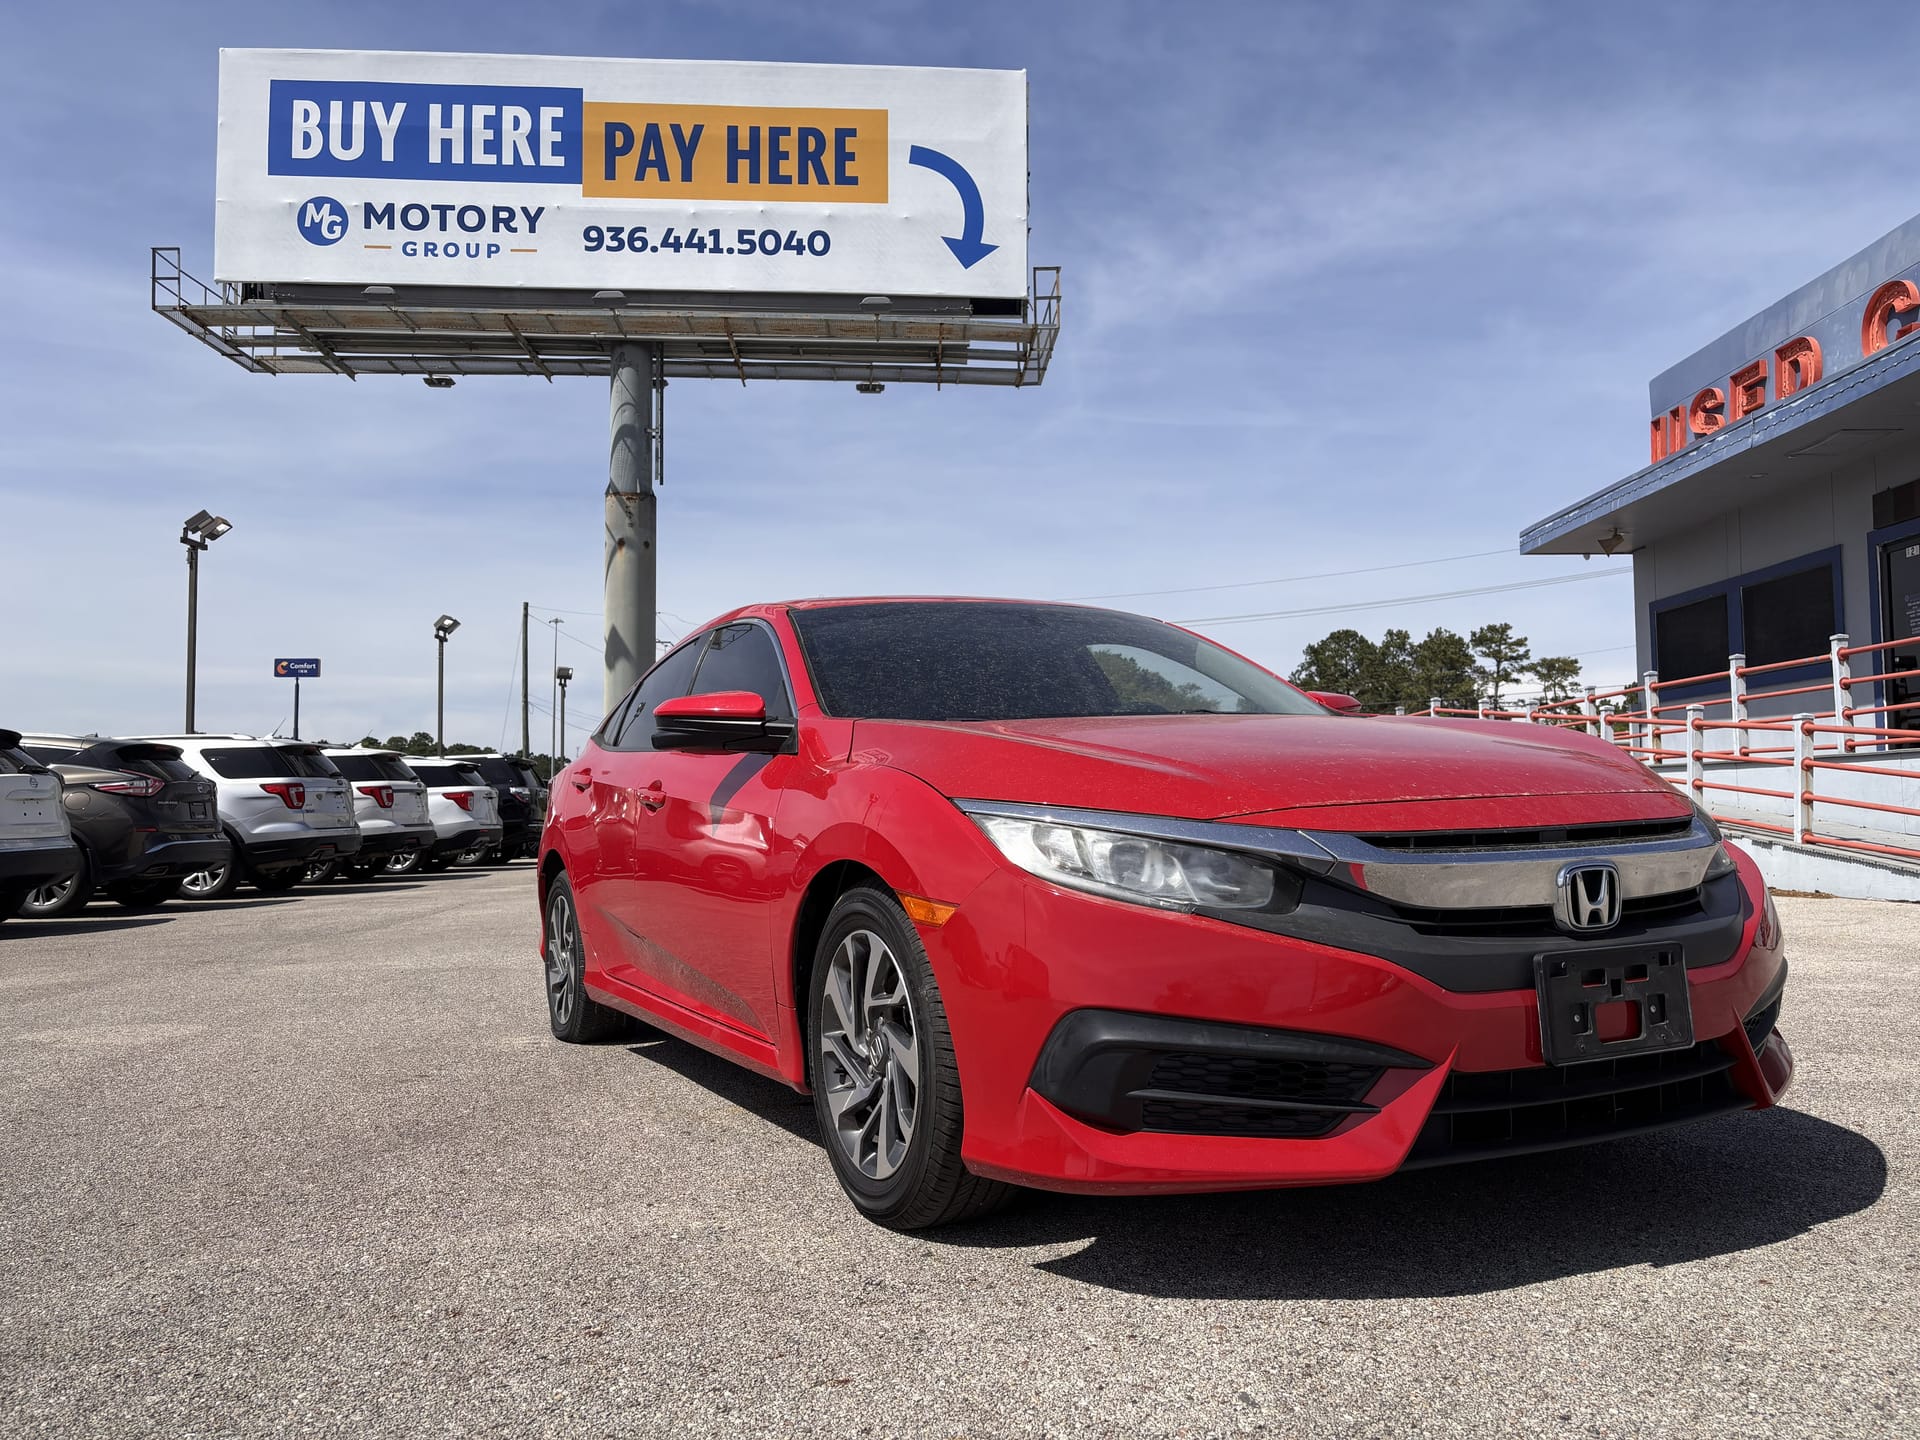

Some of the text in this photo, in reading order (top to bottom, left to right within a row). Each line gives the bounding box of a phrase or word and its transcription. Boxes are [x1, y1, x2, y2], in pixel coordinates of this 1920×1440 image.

[291, 99, 565, 167] BUY HERE
[604, 122, 859, 185] PAY HERE
[304, 202, 343, 240] MG
[363, 202, 546, 233] MOTORY
[402, 241, 501, 259] GROUP
[582, 225, 831, 256] 936.441.5040
[1650, 336, 1823, 465] USED
